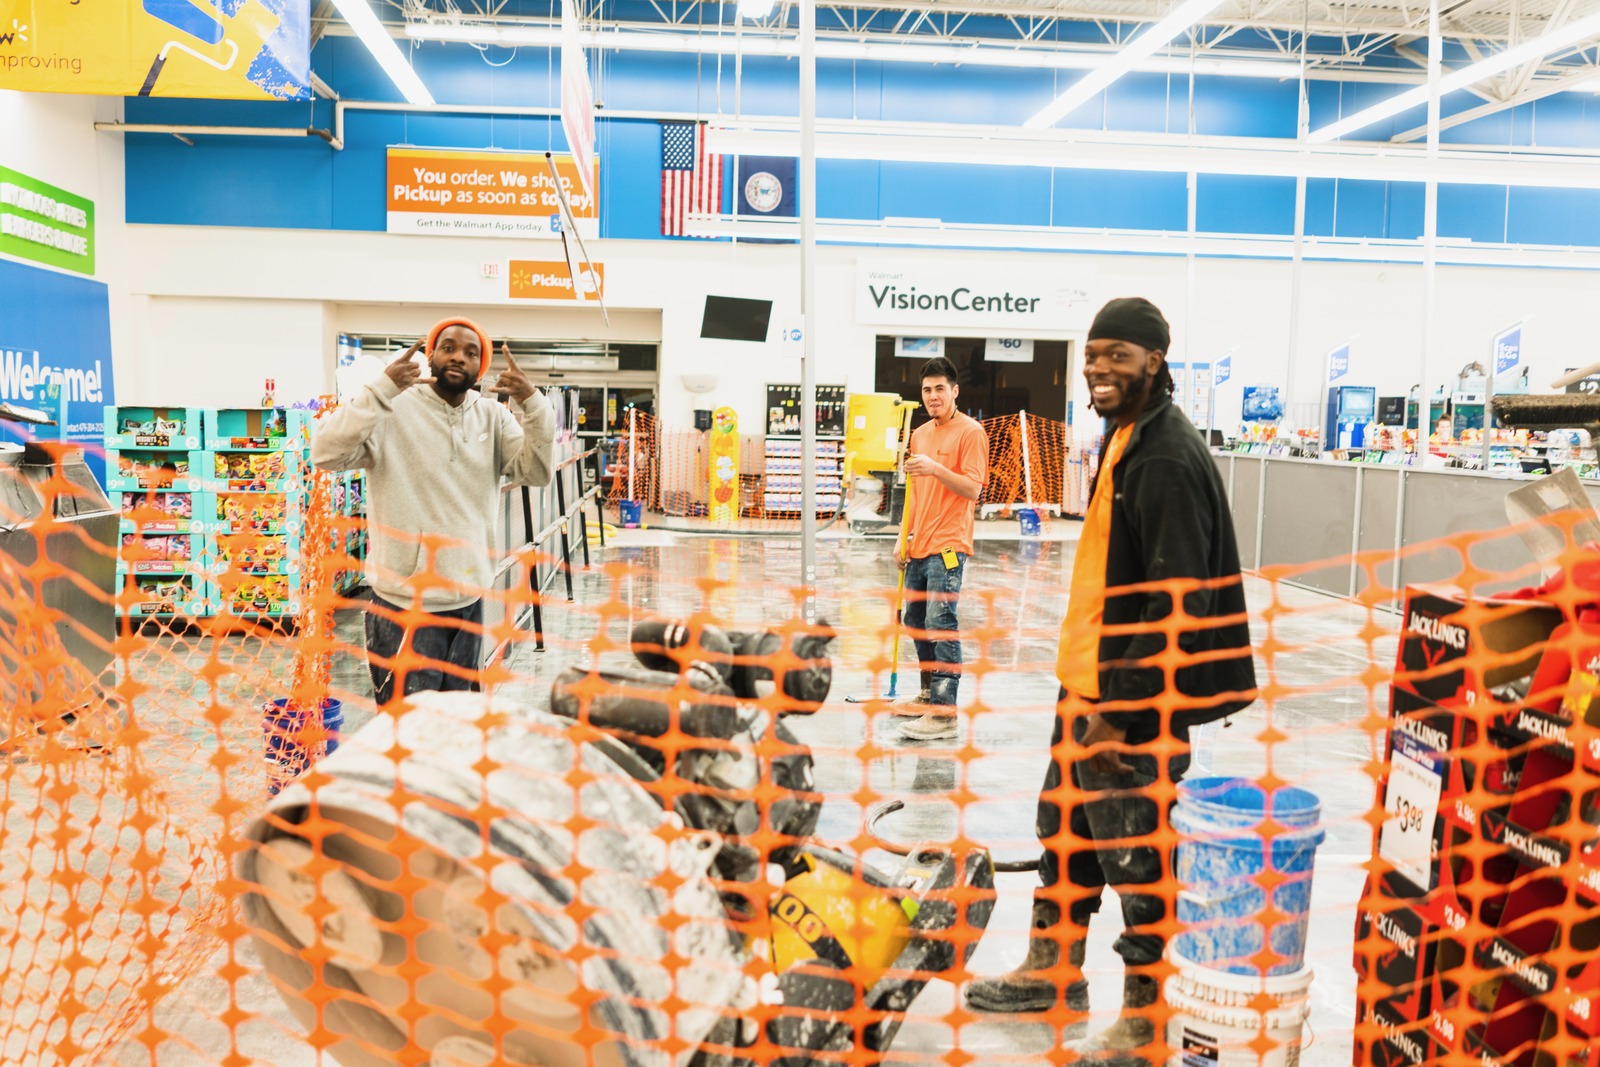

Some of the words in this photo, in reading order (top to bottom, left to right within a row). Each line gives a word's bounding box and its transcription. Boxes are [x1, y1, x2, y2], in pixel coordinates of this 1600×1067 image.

[414, 168, 446, 184] You
[450, 170, 496, 187] order.
[500, 171, 527, 187] We
[394, 185, 452, 206] Pickup
[456, 191, 473, 203] as
[477, 192, 516, 205] soon
[520, 193, 537, 205] as
[417, 219, 433, 227] Get
[436, 219, 451, 227] the
[453, 220, 492, 230] Walmart
[495, 221, 513, 231] App
[516, 222, 543, 233] today.
[483, 264, 499, 276] EXIT
[868, 271, 904, 280] Walmart
[532, 273, 574, 290] Pickup
[868, 285, 1041, 313] VisionCenter
[269, 438, 280, 446] 170
[1408, 611, 1433, 640] JACK
[1393, 710, 1418, 741] JACK
[1517, 711, 1543, 738] JACK
[1503, 826, 1528, 854] JACK
[1491, 941, 1516, 970] JACK
